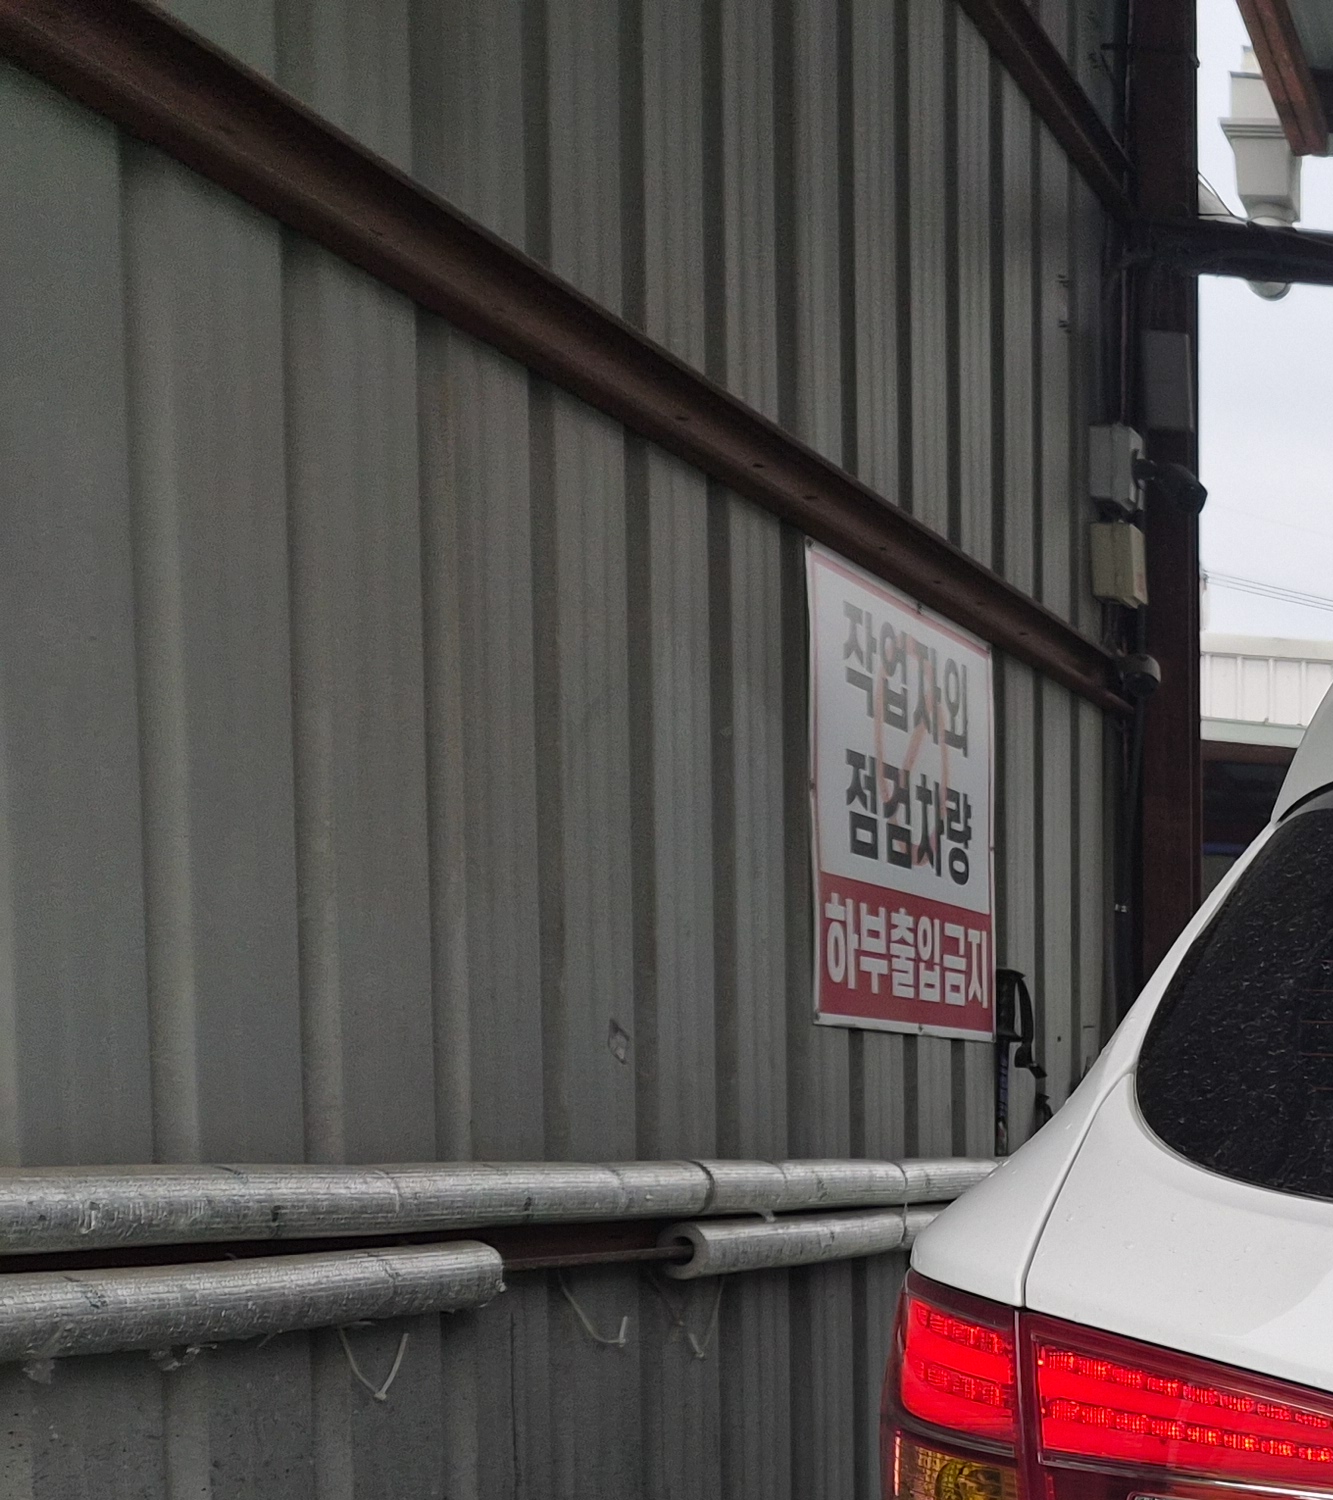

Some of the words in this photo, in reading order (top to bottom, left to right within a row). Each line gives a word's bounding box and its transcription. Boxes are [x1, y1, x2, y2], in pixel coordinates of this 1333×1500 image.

[843, 600, 968, 758] 작업자외
[845, 748, 972, 886] 점검차량
[825, 892, 988, 1009] 하부출입금지
